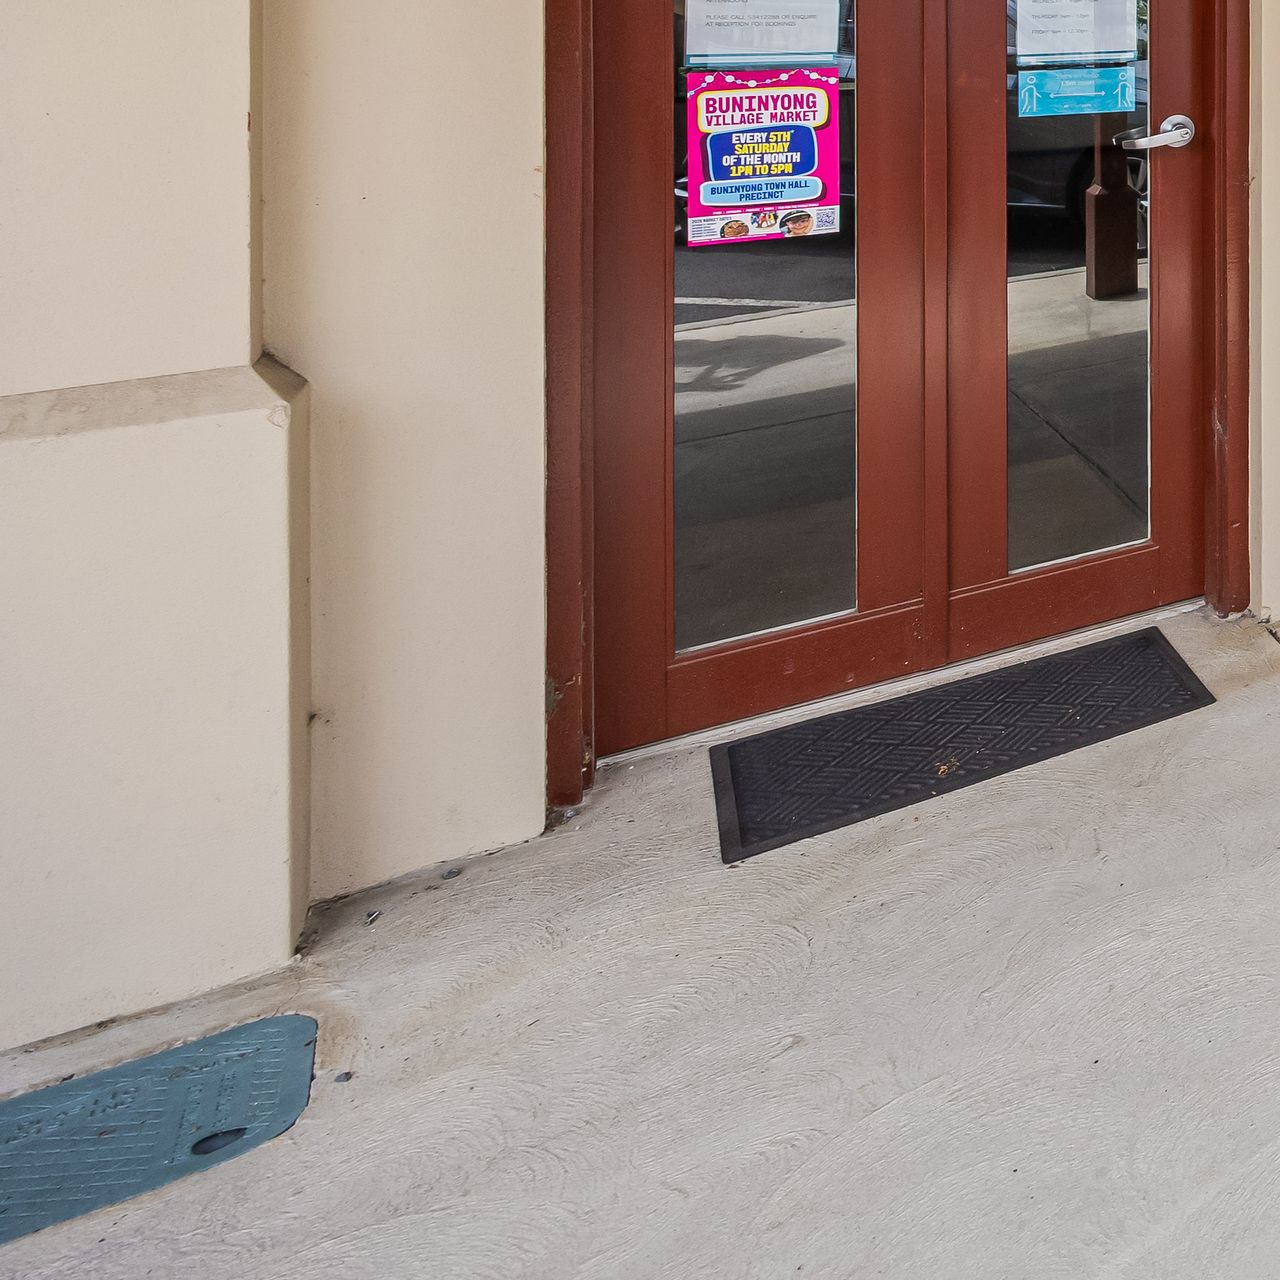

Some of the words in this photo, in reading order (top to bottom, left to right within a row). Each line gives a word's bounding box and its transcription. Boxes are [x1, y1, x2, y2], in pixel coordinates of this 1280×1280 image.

[705, 93, 817, 114] BUNINYONG
[706, 113, 764, 127] VILLAGE
[770, 110, 818, 123] MARKET
[732, 132, 768, 144] EVERY
[734, 142, 789, 155] SATURDAY
[722, 155, 740, 166] OF
[740, 154, 762, 165] THE
[763, 152, 801, 164] MONTH
[730, 165, 753, 177] 1PM
[755, 164, 769, 175] TO
[770, 163, 793, 174] 5PM
[710, 183, 763, 195] BUNINYONG
[764, 182, 787, 191] TOWN
[787, 180, 810, 189] HALL
[739, 191, 784, 202] PRECINCT
